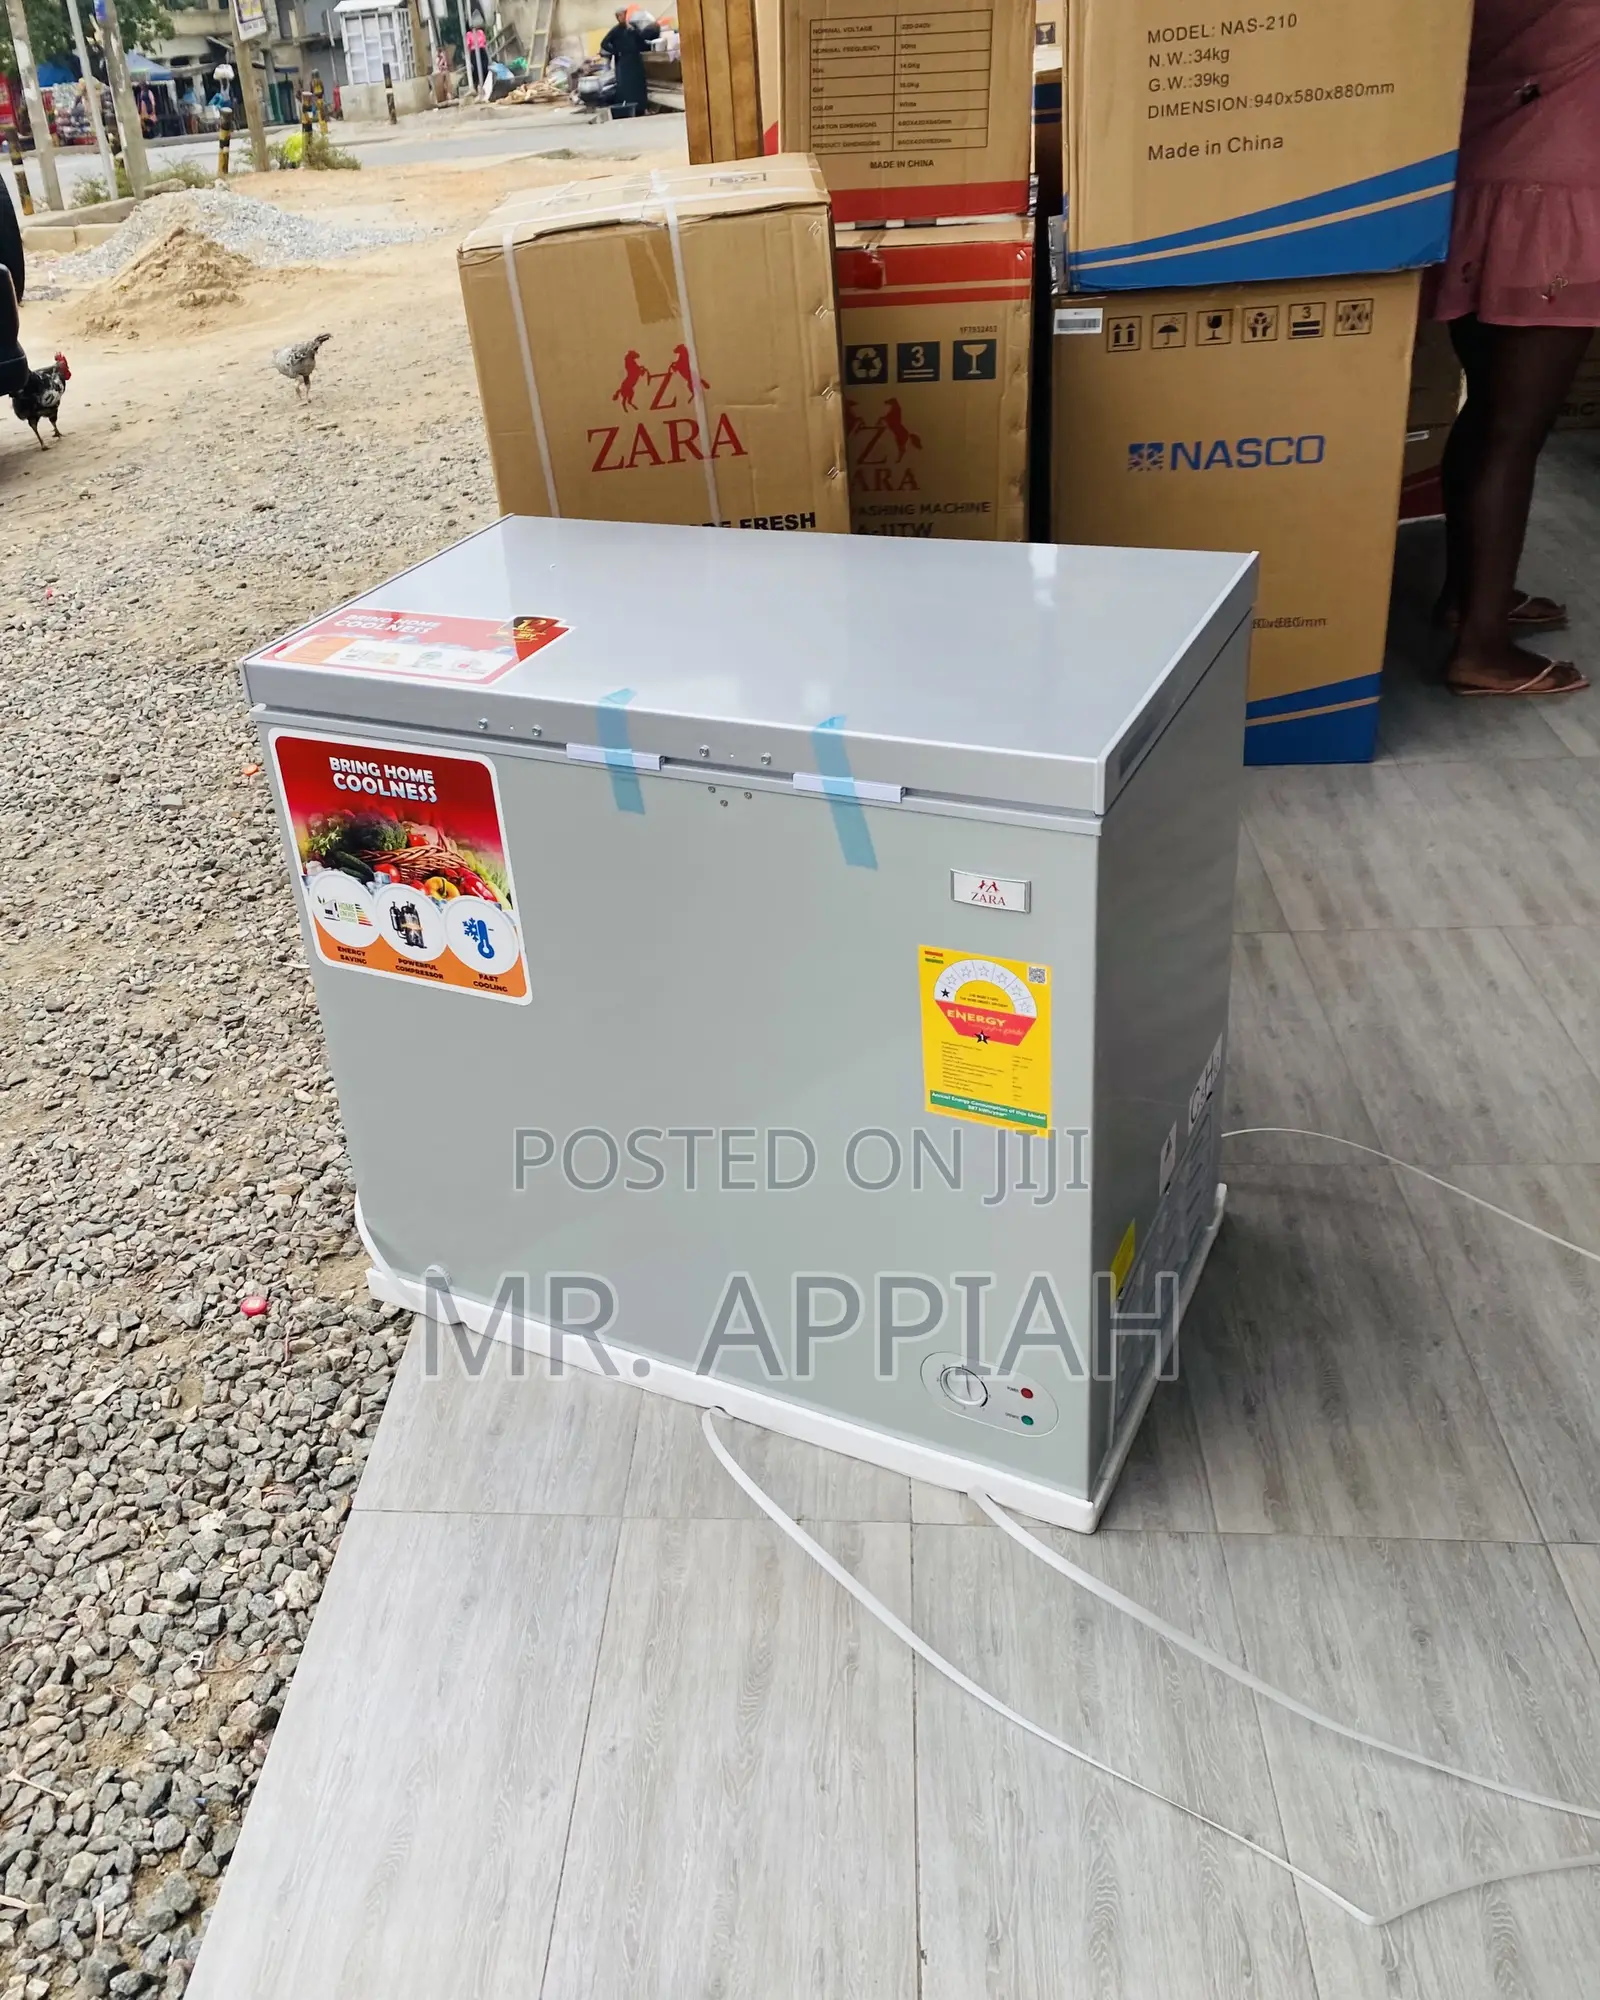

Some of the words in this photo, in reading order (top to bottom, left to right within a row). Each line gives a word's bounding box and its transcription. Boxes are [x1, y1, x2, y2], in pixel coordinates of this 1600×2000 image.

[1148, 24, 1215, 44] MODEL:
[1221, 13, 1297, 36] NAS-210
[1148, 143, 1200, 161] Made
[1205, 140, 1222, 156] in
[1228, 135, 1284, 154] China
[870, 161, 895, 169] MADE
[897, 160, 906, 168] IN
[907, 159, 935, 168] CHINA
[1301, 306, 1313, 319] 3
[911, 345, 925, 368] 3
[587, 413, 748, 473] ZARA
[1169, 435, 1326, 471] NASCO
[852, 468, 920, 492] ARA
[852, 503, 916, 517] ASHING
[919, 501, 992, 516] MACHINE
[740, 512, 816, 531] FRESH
[329, 756, 382, 777] BRING
[384, 764, 435, 785] HOME
[333, 772, 438, 803] COOLNESS
[970, 891, 1007, 907] ZARA
[337, 946, 366, 957] ENERGY
[340, 954, 367, 965] SAVING
[395, 965, 444, 980] COMPRESSOR
[397, 958, 438, 971] POWERFUL
[473, 980, 509, 993] COOLING
[478, 974, 499, 983] FAST
[947, 1009, 1006, 1027] ENERGY
[951, 1096, 970, 1105] Energy
